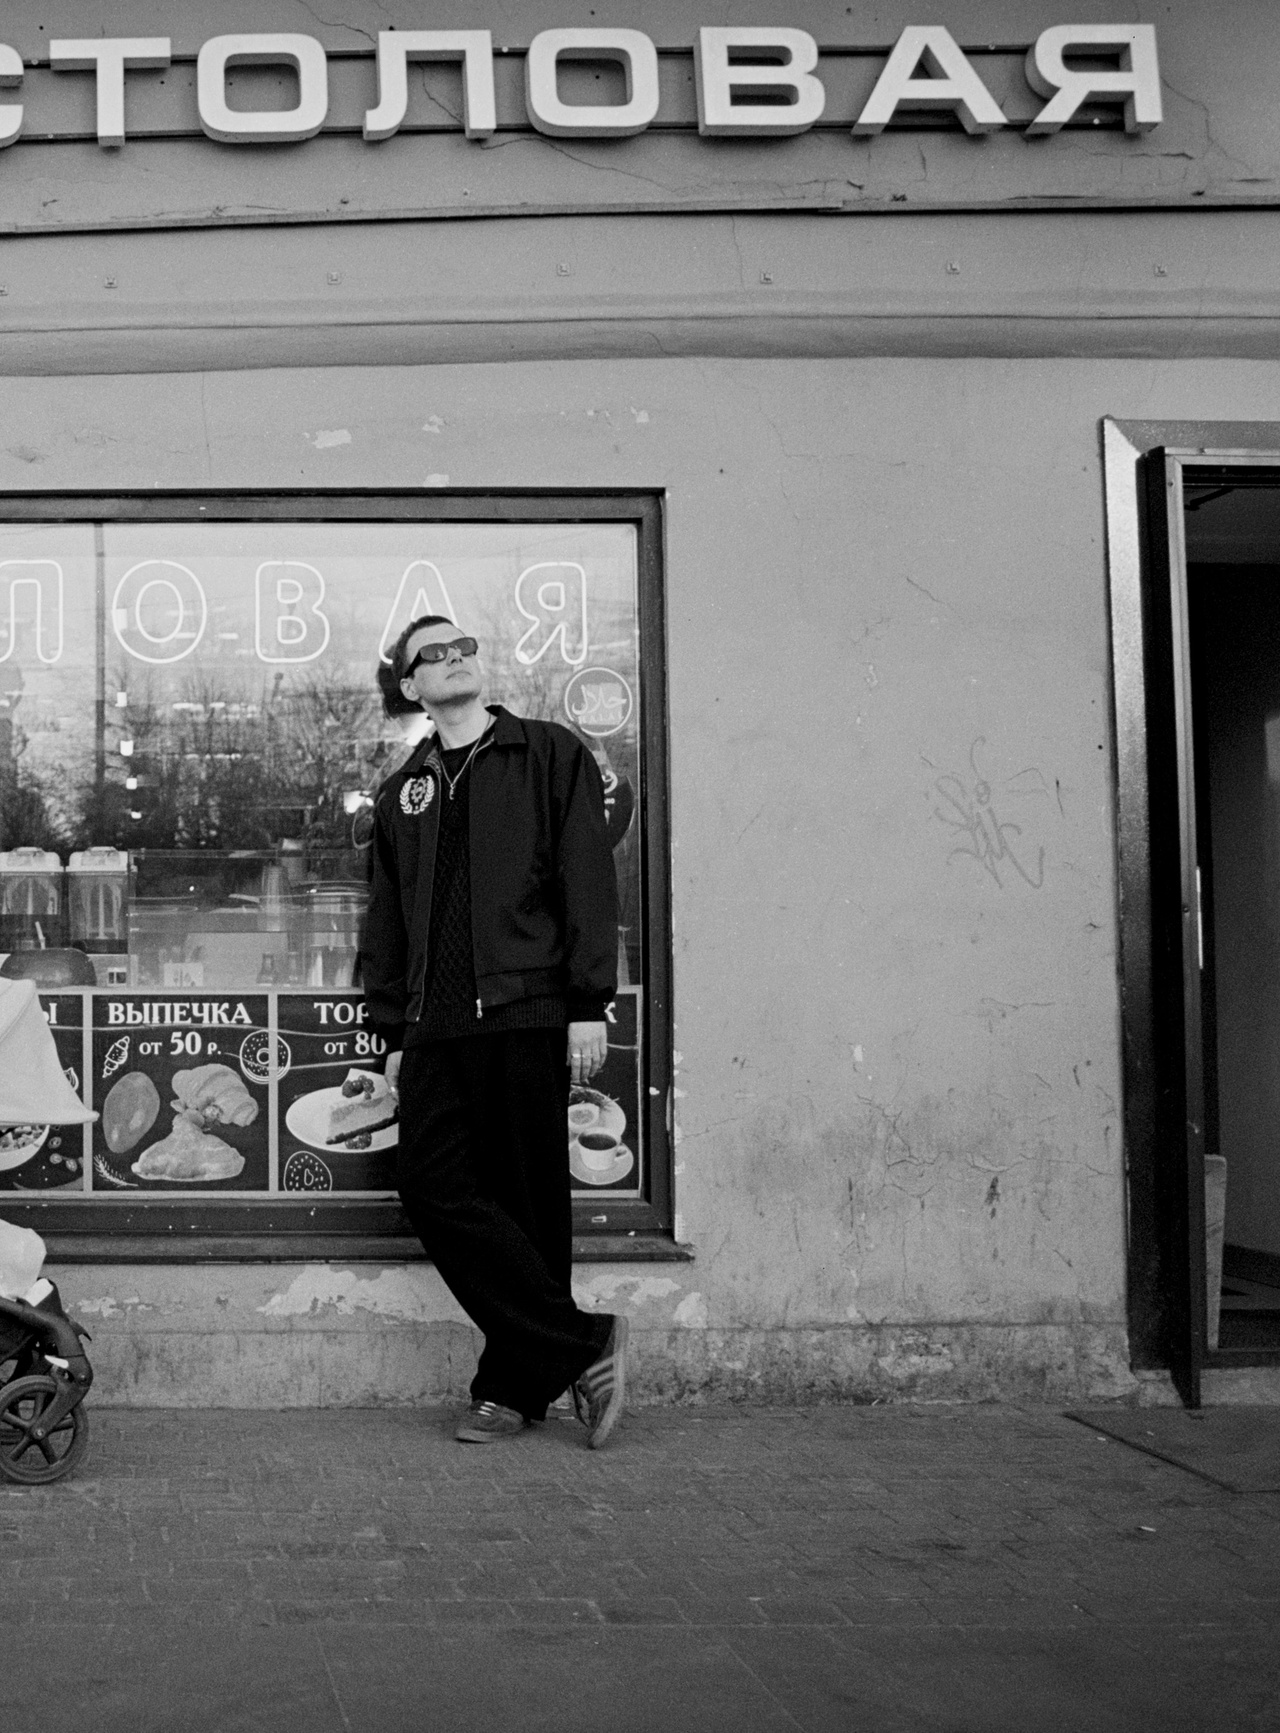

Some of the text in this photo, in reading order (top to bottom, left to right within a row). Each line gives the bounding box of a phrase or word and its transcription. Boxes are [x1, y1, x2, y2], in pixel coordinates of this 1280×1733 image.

[108, 1002, 253, 1025] ВЫПЕЧКА
[313, 1002, 369, 1024] ТОР
[138, 1031, 222, 1057] от 50 р.
[323, 1031, 387, 1055] от 80
